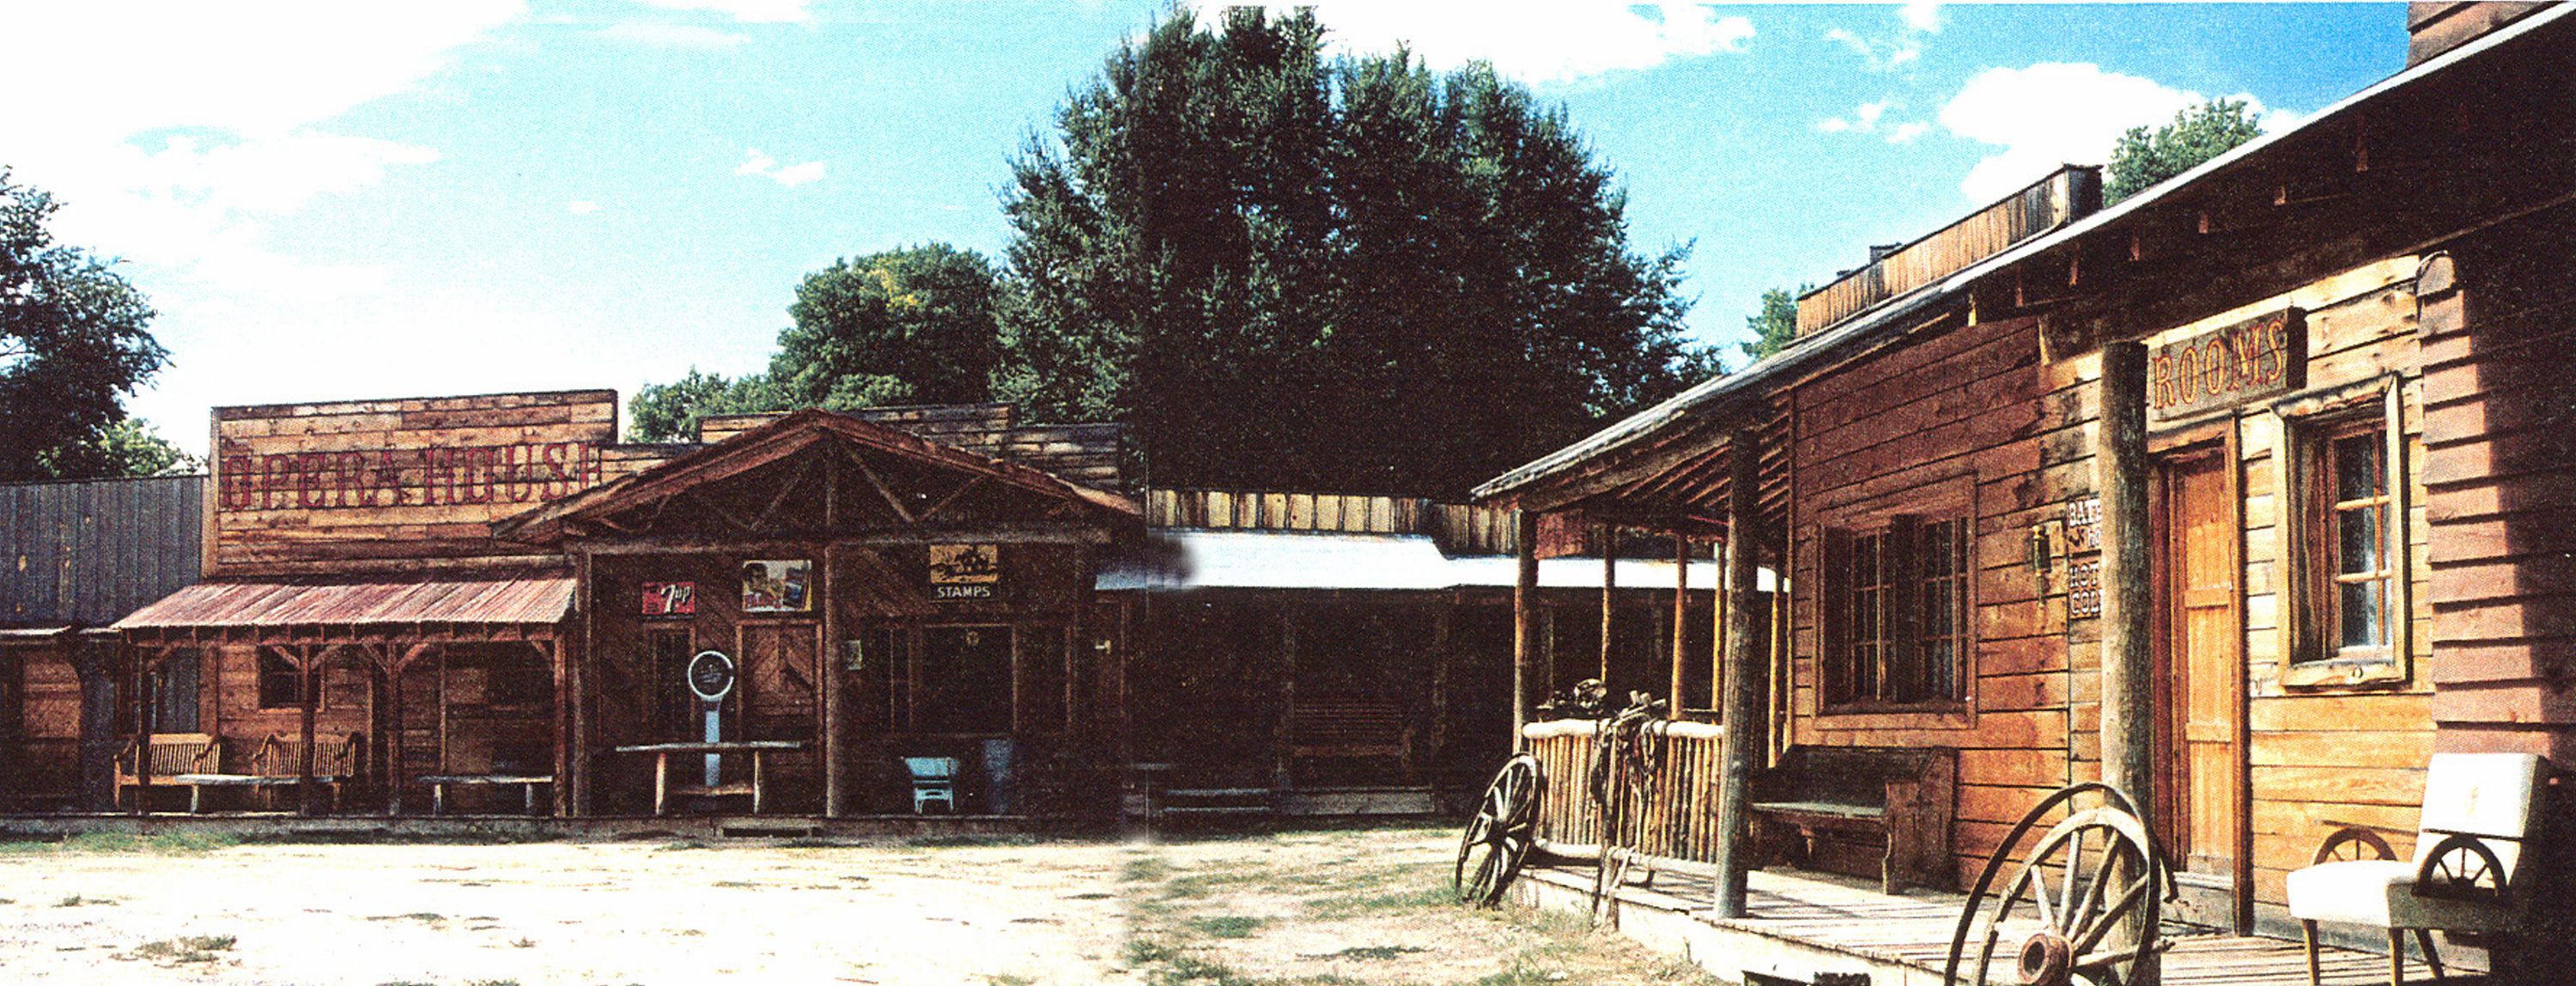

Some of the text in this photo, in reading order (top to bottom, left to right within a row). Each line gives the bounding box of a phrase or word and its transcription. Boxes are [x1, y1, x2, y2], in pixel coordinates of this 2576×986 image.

[2153, 319, 2285, 410] ROOMS
[223, 450, 410, 511] OPERA
[937, 585, 992, 599] STAMPS
[2069, 561, 2099, 587] HOT
